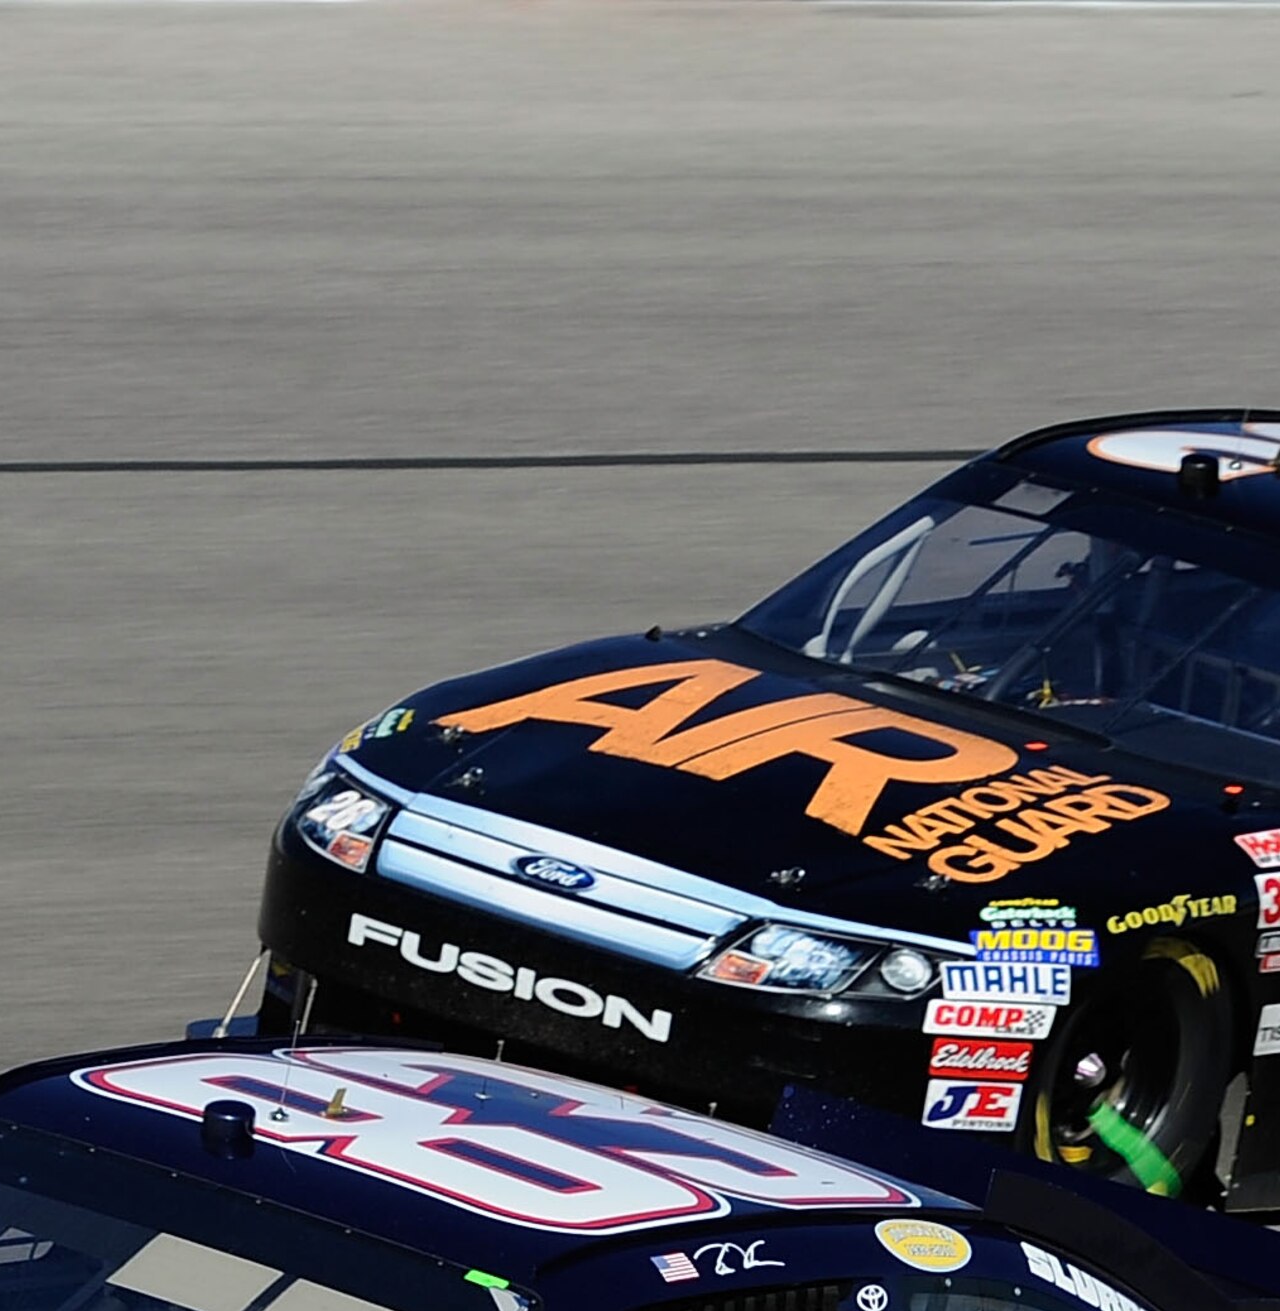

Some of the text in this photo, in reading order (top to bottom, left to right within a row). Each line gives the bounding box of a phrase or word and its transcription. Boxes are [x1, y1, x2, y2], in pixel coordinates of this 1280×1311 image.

[428, 658, 1019, 836] AIR
[863, 765, 1112, 860] NATIONAL
[928, 784, 1171, 883] GUARD
[524, 858, 586, 887] Ford
[1106, 894, 1238, 934] GOODYEAR
[976, 930, 1095, 951] MOOG
[981, 950, 1097, 965] CHASSIS PARTS
[348, 913, 672, 1043] FUSION
[945, 965, 1067, 996] MAHLE
[934, 1005, 1024, 1028] COMP
[930, 1043, 1031, 1073] Edelbrock
[926, 1085, 1014, 1122] JE
